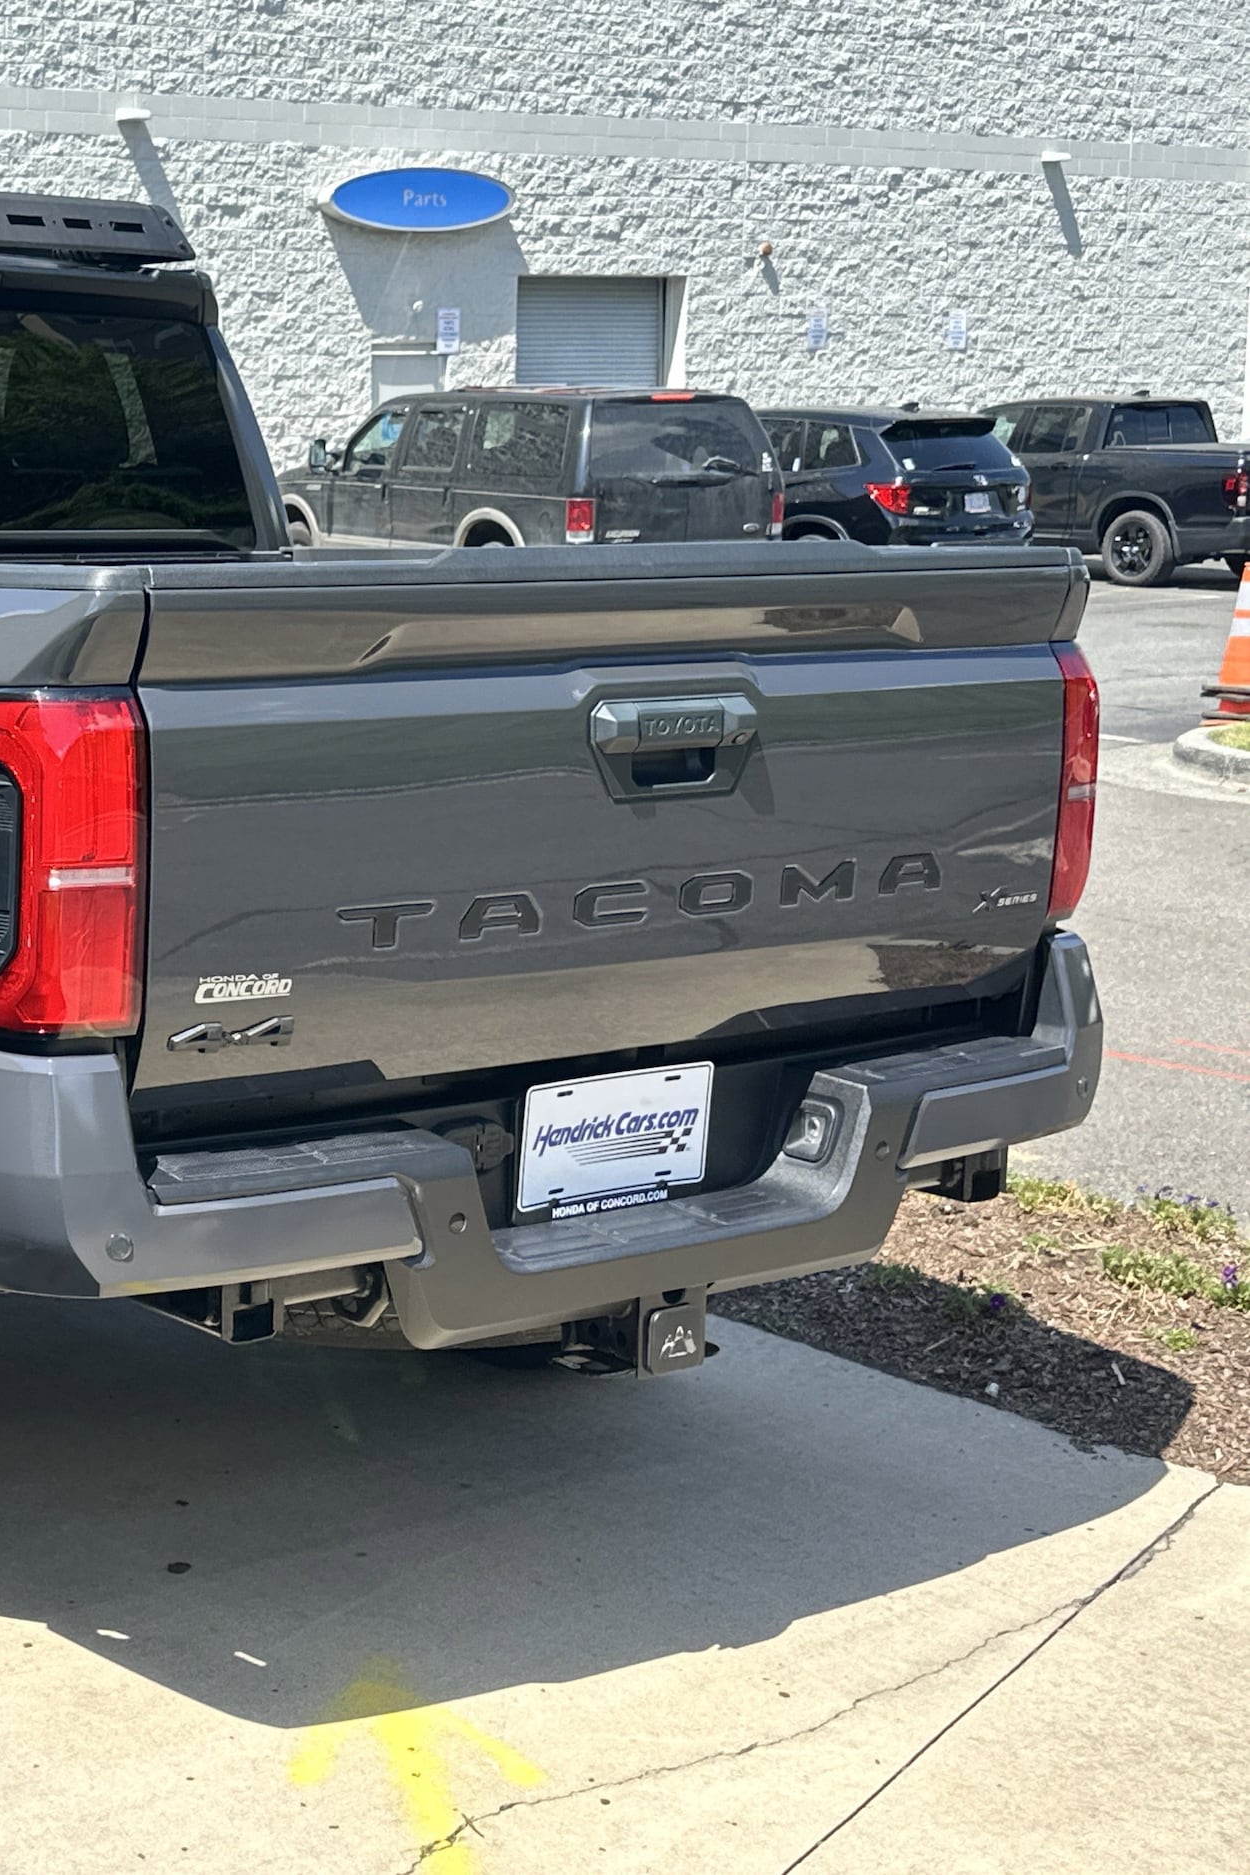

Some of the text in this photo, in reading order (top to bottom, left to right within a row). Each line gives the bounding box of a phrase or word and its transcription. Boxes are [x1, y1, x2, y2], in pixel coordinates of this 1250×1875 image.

[402, 187, 447, 207] Parts
[643, 715, 720, 737] TOYOTA
[336, 851, 943, 951] TACOMA
[997, 893, 1038, 907] SERIES
[200, 974, 258, 982] HONDA
[195, 979, 293, 1004] CONCORD
[551, 1190, 668, 1219] HONDA OF CONCORD.COM
